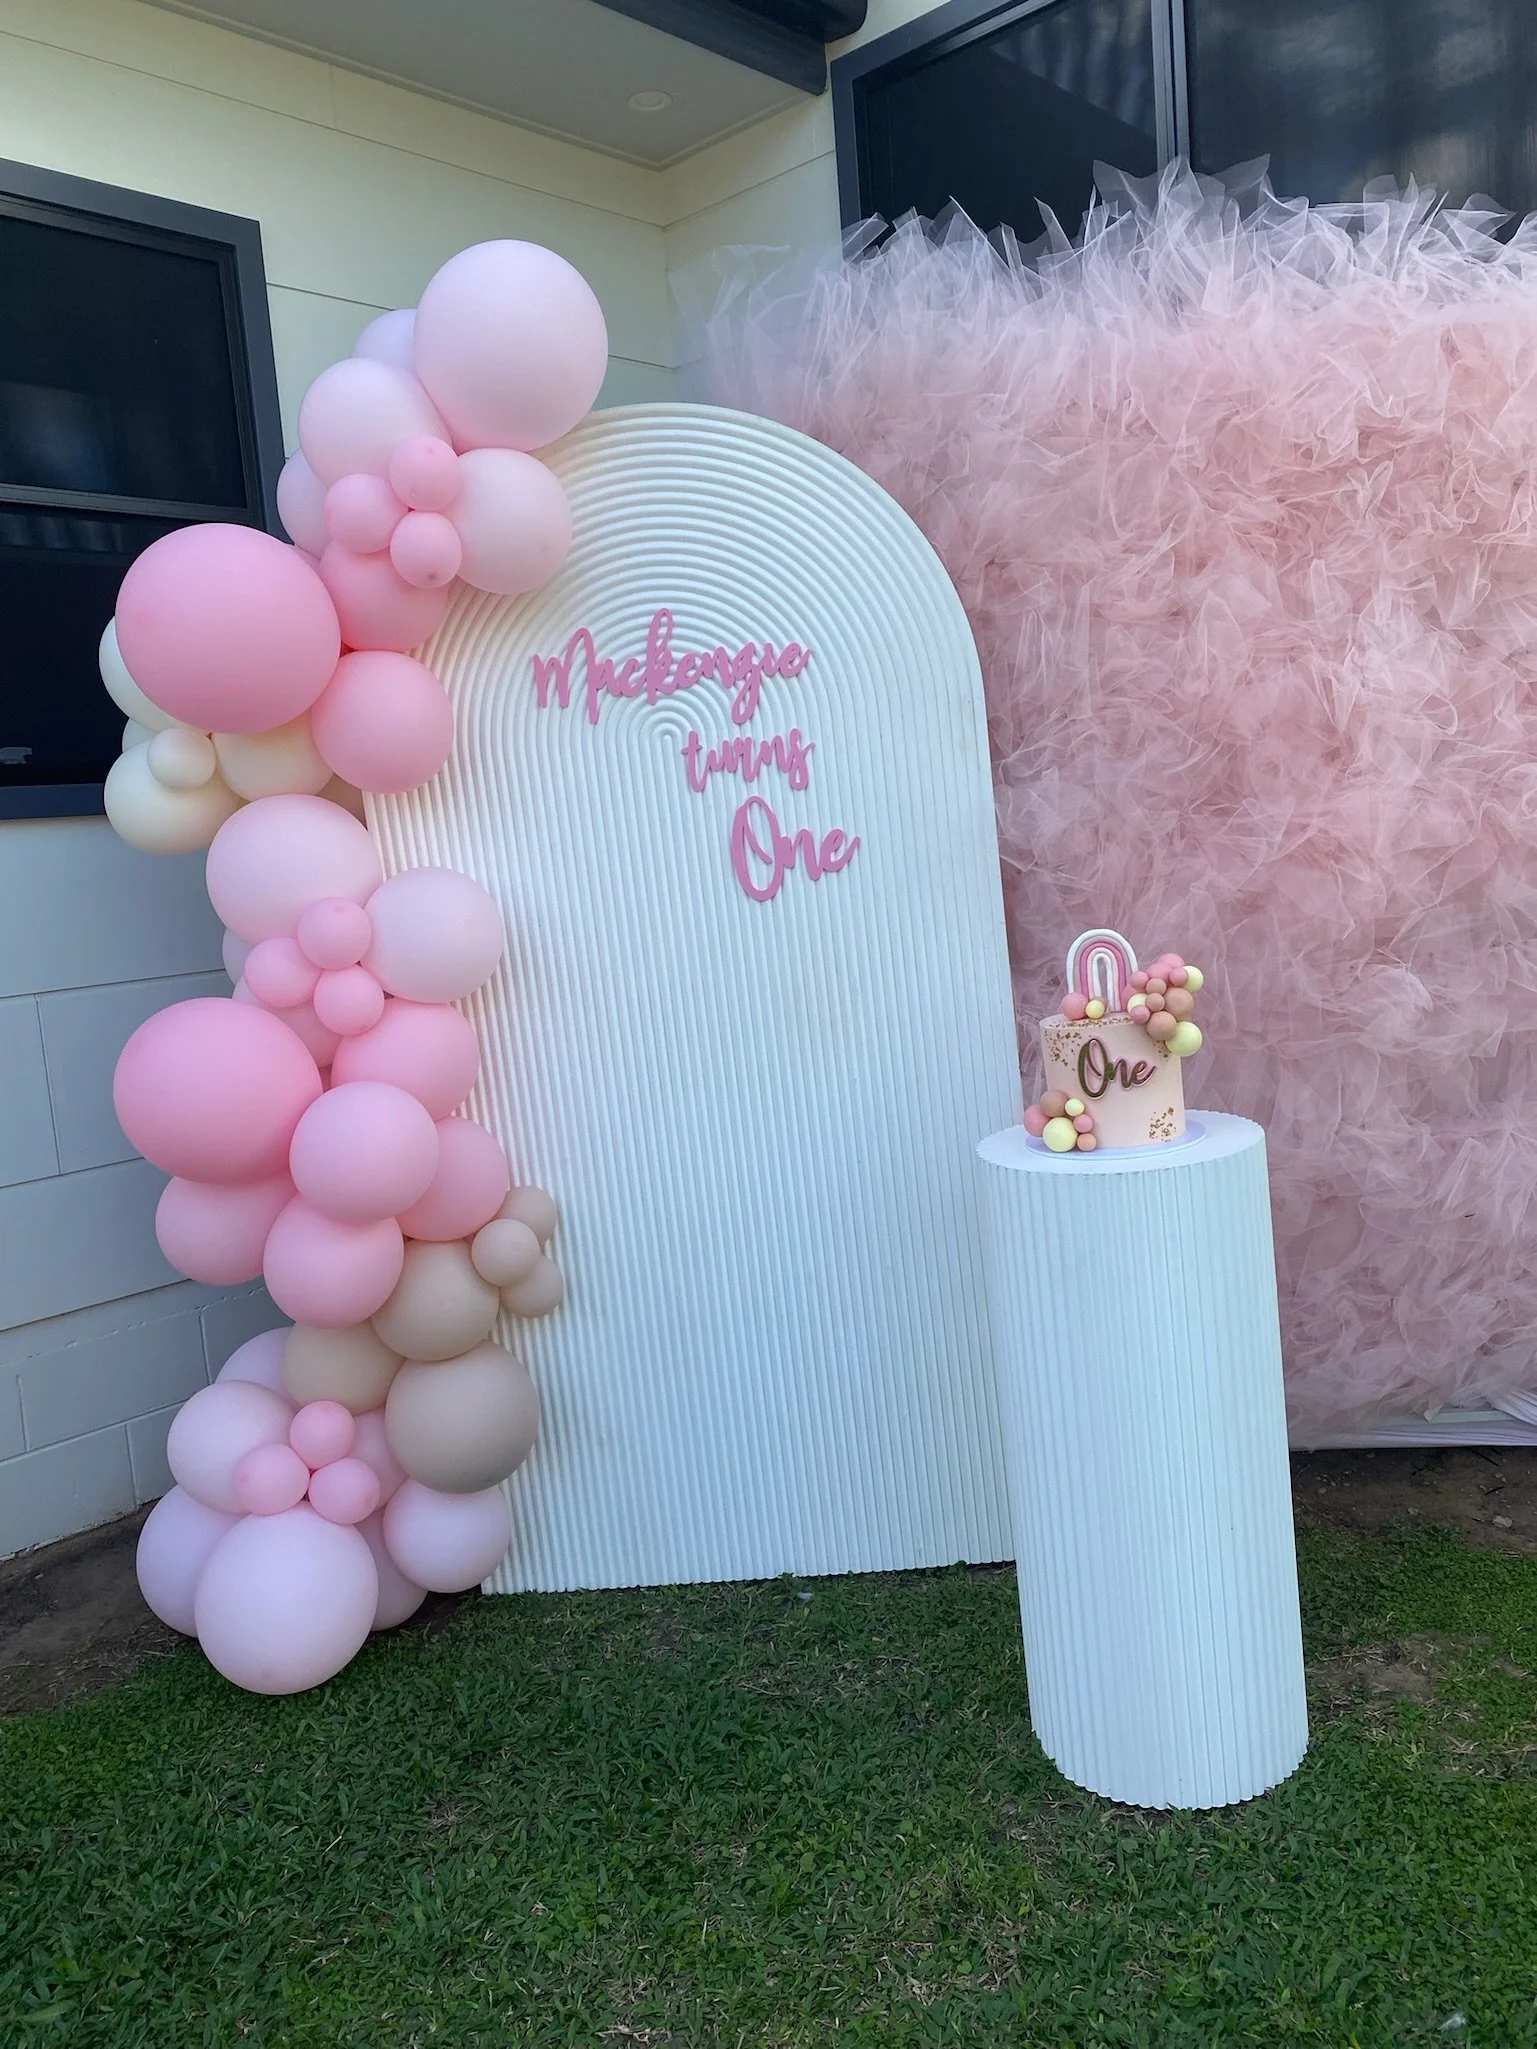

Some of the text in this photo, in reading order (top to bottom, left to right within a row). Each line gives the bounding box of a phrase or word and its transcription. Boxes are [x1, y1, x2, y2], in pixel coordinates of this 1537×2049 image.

[681, 728, 816, 793] turns
[731, 795, 861, 902] One
[1078, 1037, 1157, 1098] One
